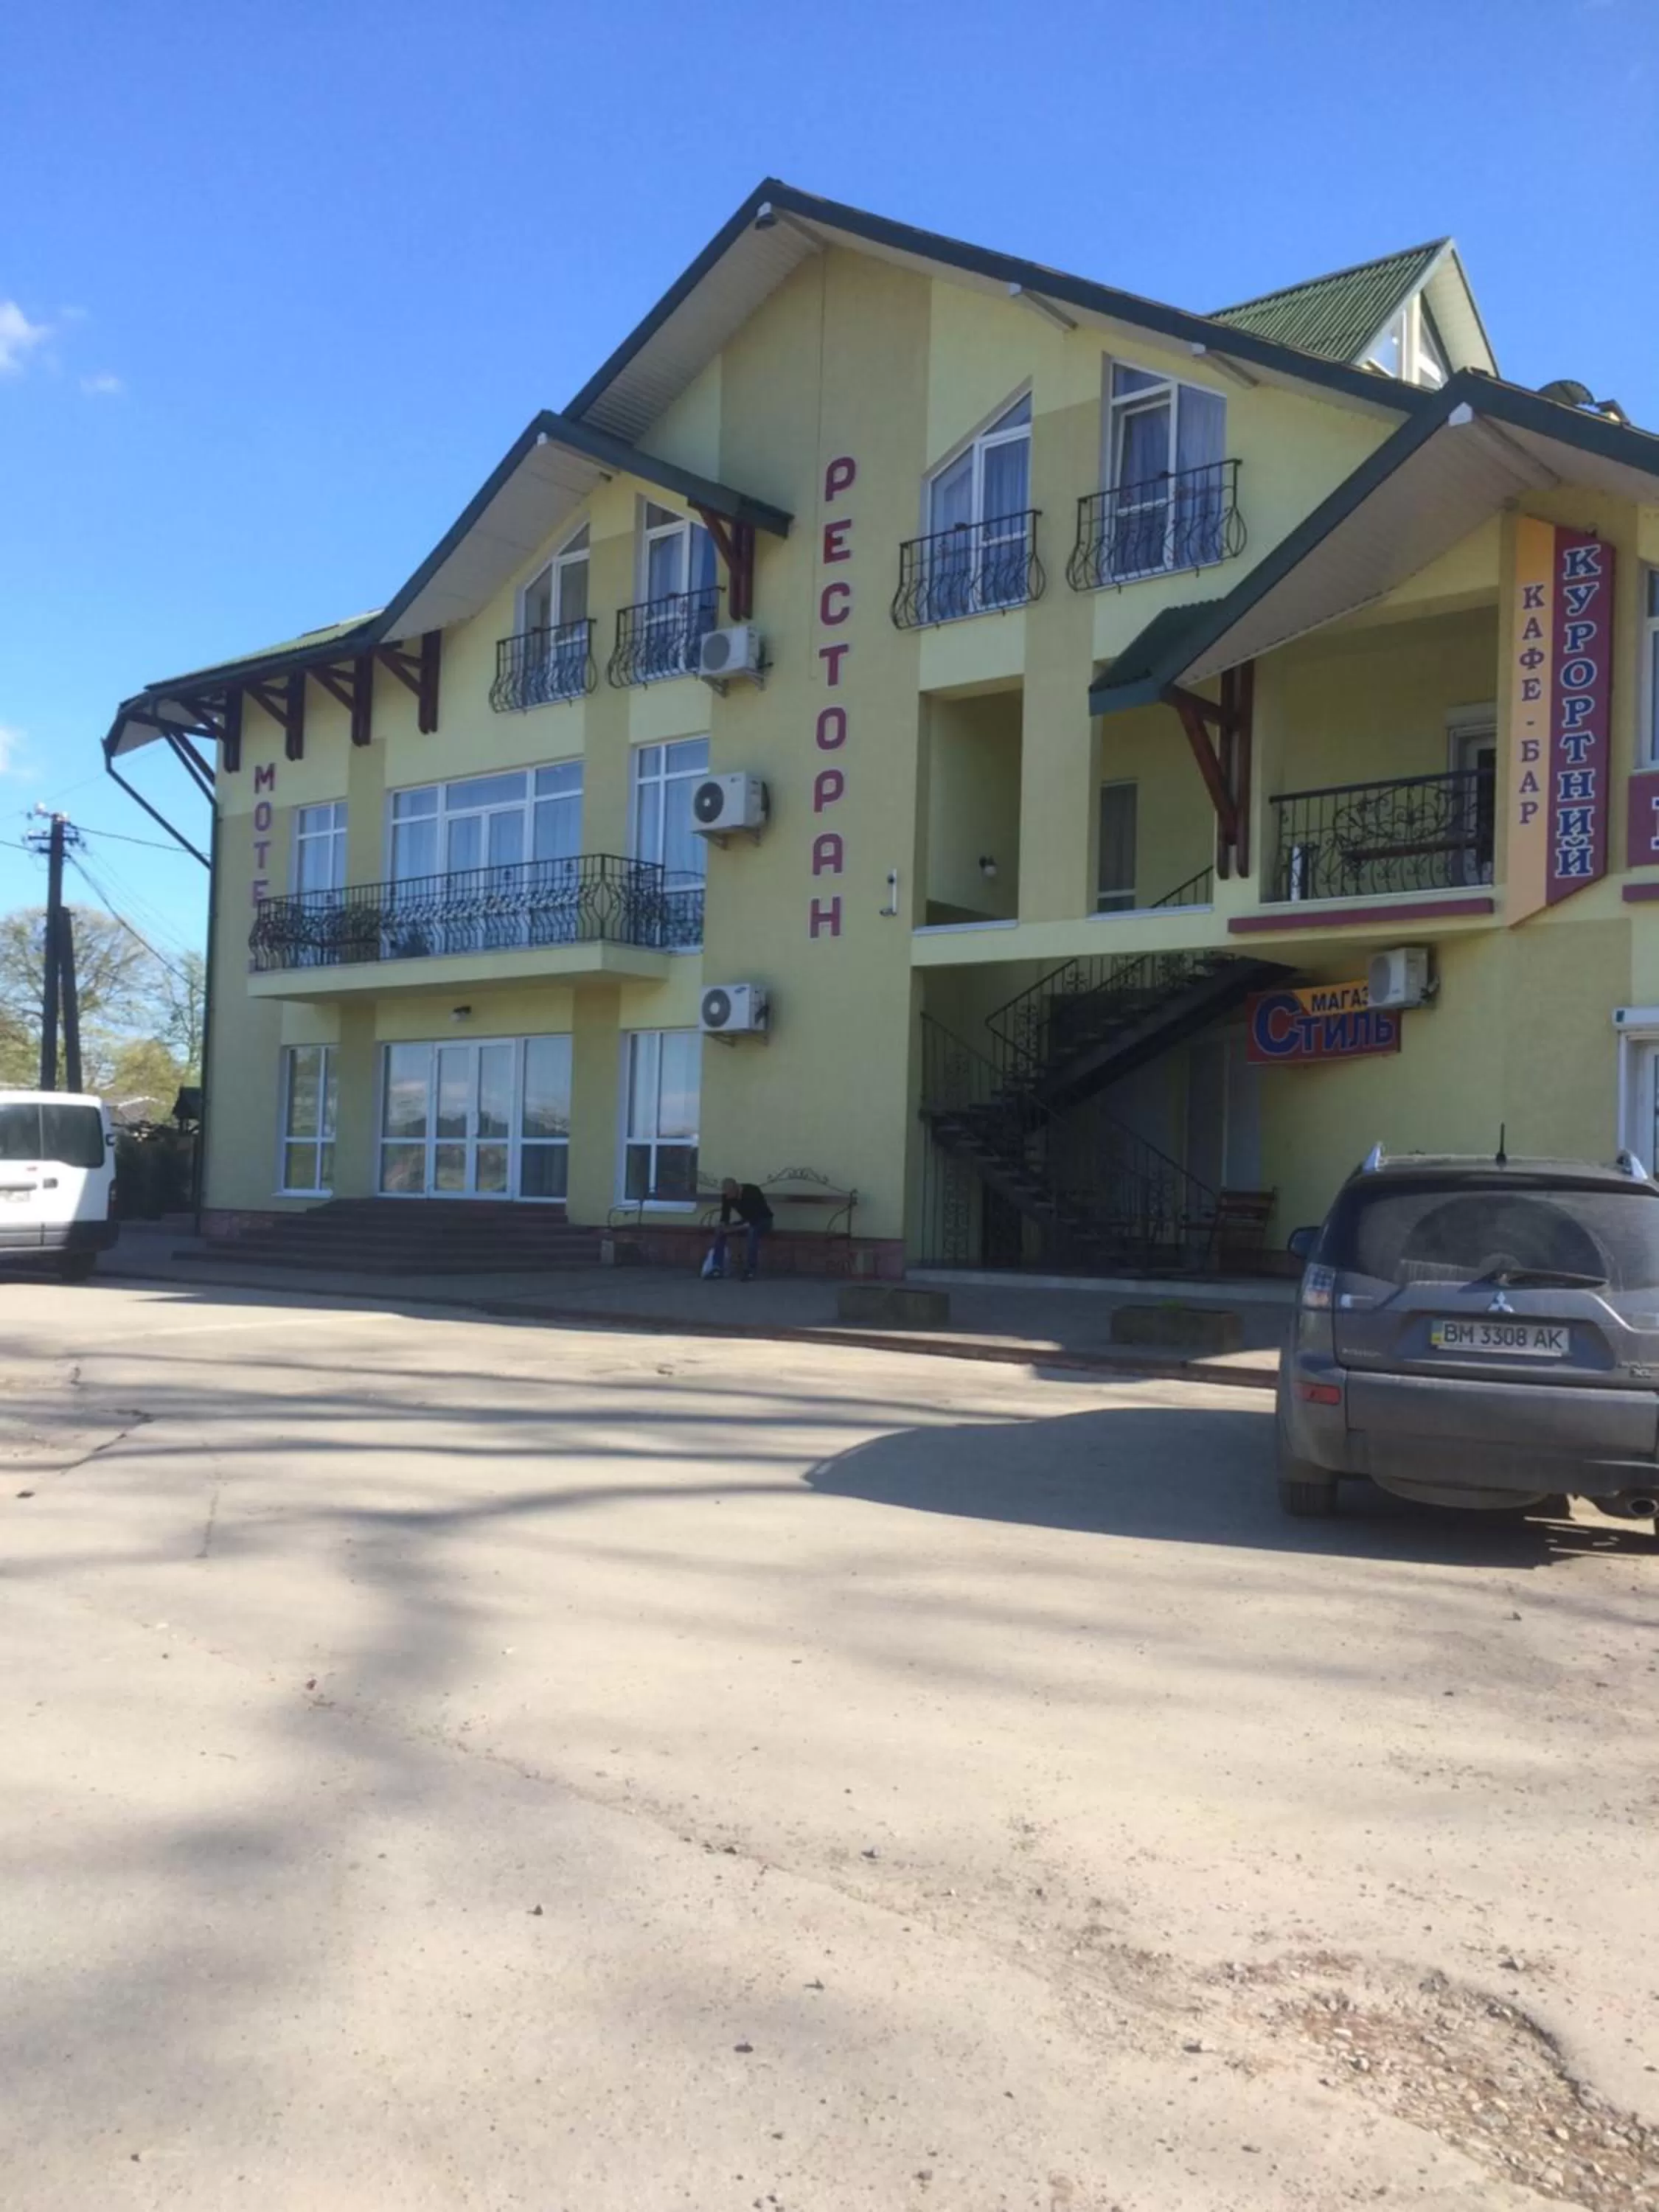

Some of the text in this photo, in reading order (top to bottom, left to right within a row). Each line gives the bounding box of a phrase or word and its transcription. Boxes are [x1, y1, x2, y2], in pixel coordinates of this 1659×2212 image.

[809, 456, 857, 939] РЕСТОРАН
[1554, 544, 1601, 878] КУРОРТНИЙ
[1311, 987, 1369, 1012] МАГАЗ
[1443, 1323, 1564, 1349] BM 3308 AK
